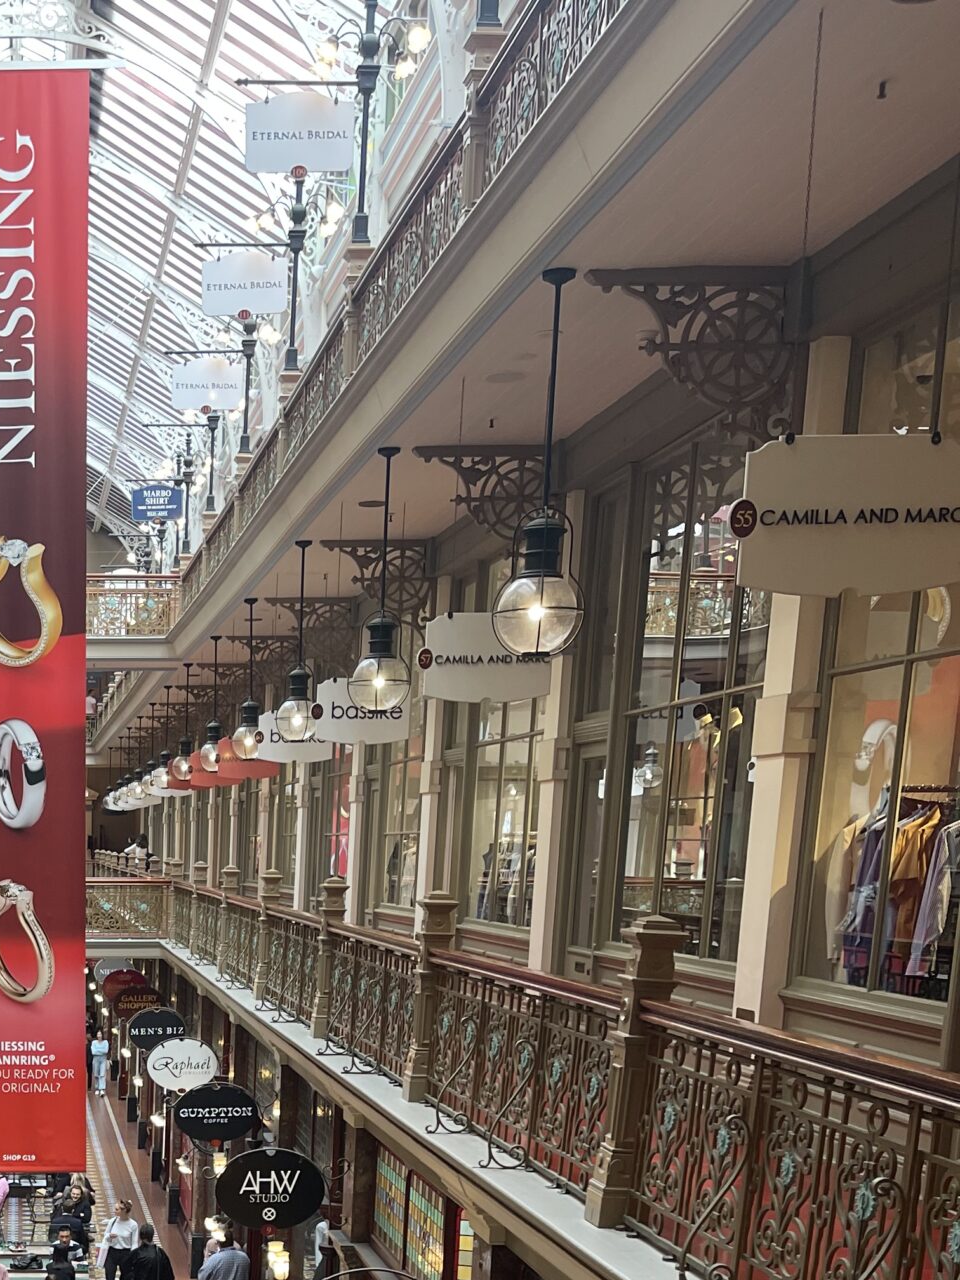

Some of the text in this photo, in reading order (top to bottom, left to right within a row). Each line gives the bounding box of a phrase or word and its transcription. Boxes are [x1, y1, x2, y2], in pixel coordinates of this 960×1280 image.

[252, 130, 348, 141] ETERNAL BRIDAL
[206, 280, 283, 292] ETERNAL BRIDAL
[175, 381, 238, 390] ETERNAL BRIDAL
[145, 497, 169, 505] SHIRT
[734, 510, 753, 528] 55
[760, 507, 960, 526] CAMILLA AND MARC
[420, 654, 431, 664] 57
[435, 654, 484, 665] CAMILLA
[487, 654, 513, 664] AND
[121, 994, 158, 1002] GALLERY
[118, 1001, 161, 1010] SHOPPING
[130, 1026, 185, 1035] MEN'S BIZ
[14, 1069, 50, 1079] READY
[52, 1069, 75, 1079] FOR
[1, 1082, 61, 1093] ORIGINAL?
[179, 1106, 253, 1118] GUMPTION
[239, 1170, 300, 1194] AHW
[249, 1194, 290, 1203] STUDIO
